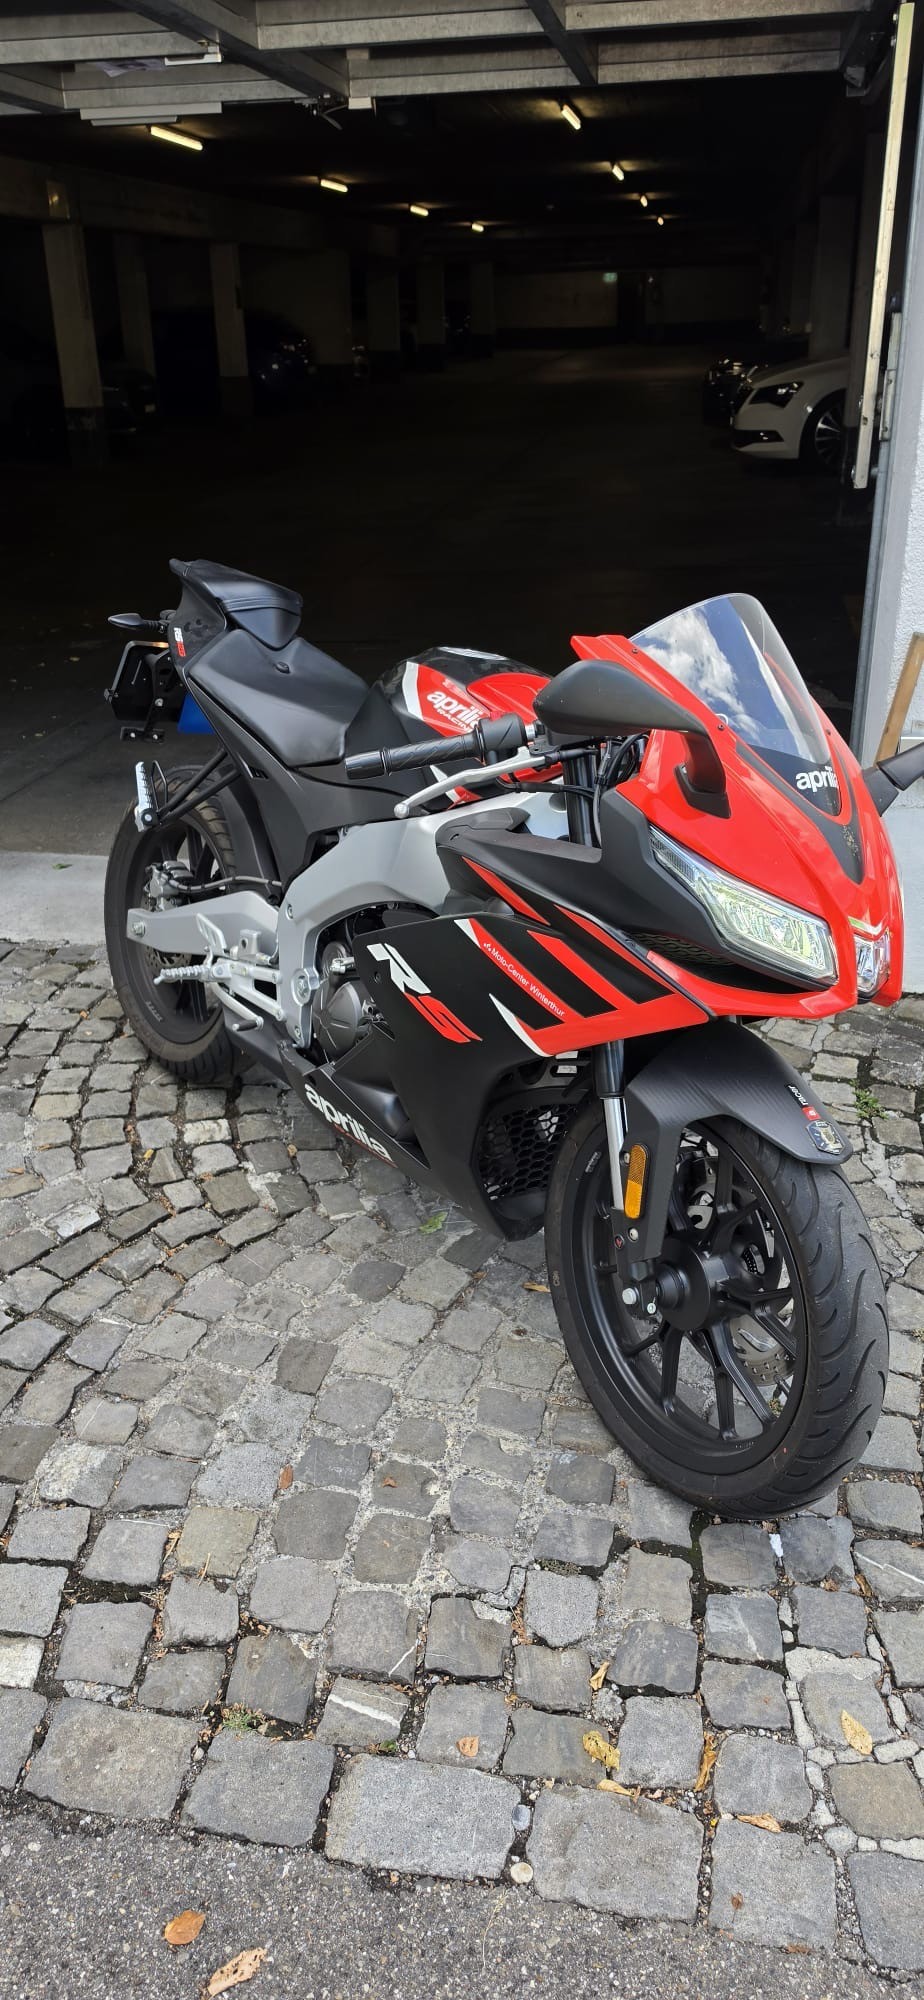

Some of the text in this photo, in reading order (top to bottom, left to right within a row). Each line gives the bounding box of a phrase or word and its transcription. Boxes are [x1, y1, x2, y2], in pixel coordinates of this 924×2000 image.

[436, 708, 471, 731] RACIN
[366, 943, 483, 1044] RS
[491, 948, 565, 1016] Moto-Center Winterthur
[304, 1083, 393, 1162] aprilia
